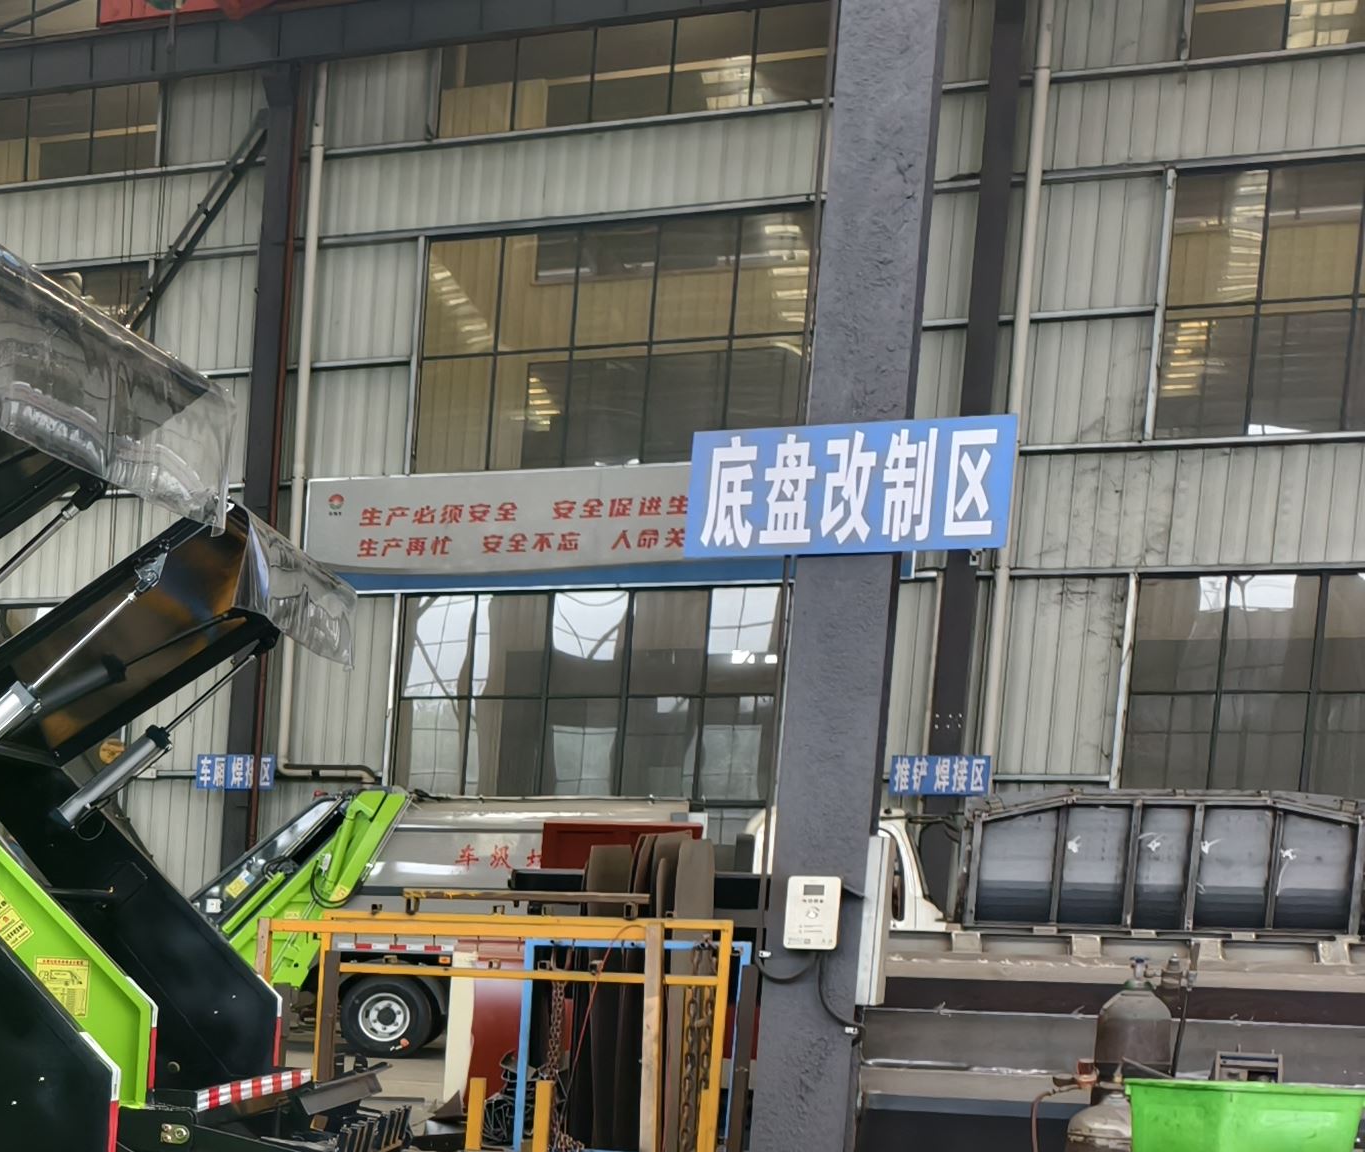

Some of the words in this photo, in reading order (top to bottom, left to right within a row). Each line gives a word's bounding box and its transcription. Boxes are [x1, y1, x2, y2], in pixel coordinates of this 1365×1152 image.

[700, 428, 998, 548] 底盘改制区
[359, 502, 518, 527] 生产必须安全
[357, 535, 453, 558] 生产再忙
[481, 532, 581, 553] 安全不忘
[611, 527, 687, 550] 人命关
[934, 756, 986, 793] 焊接区
